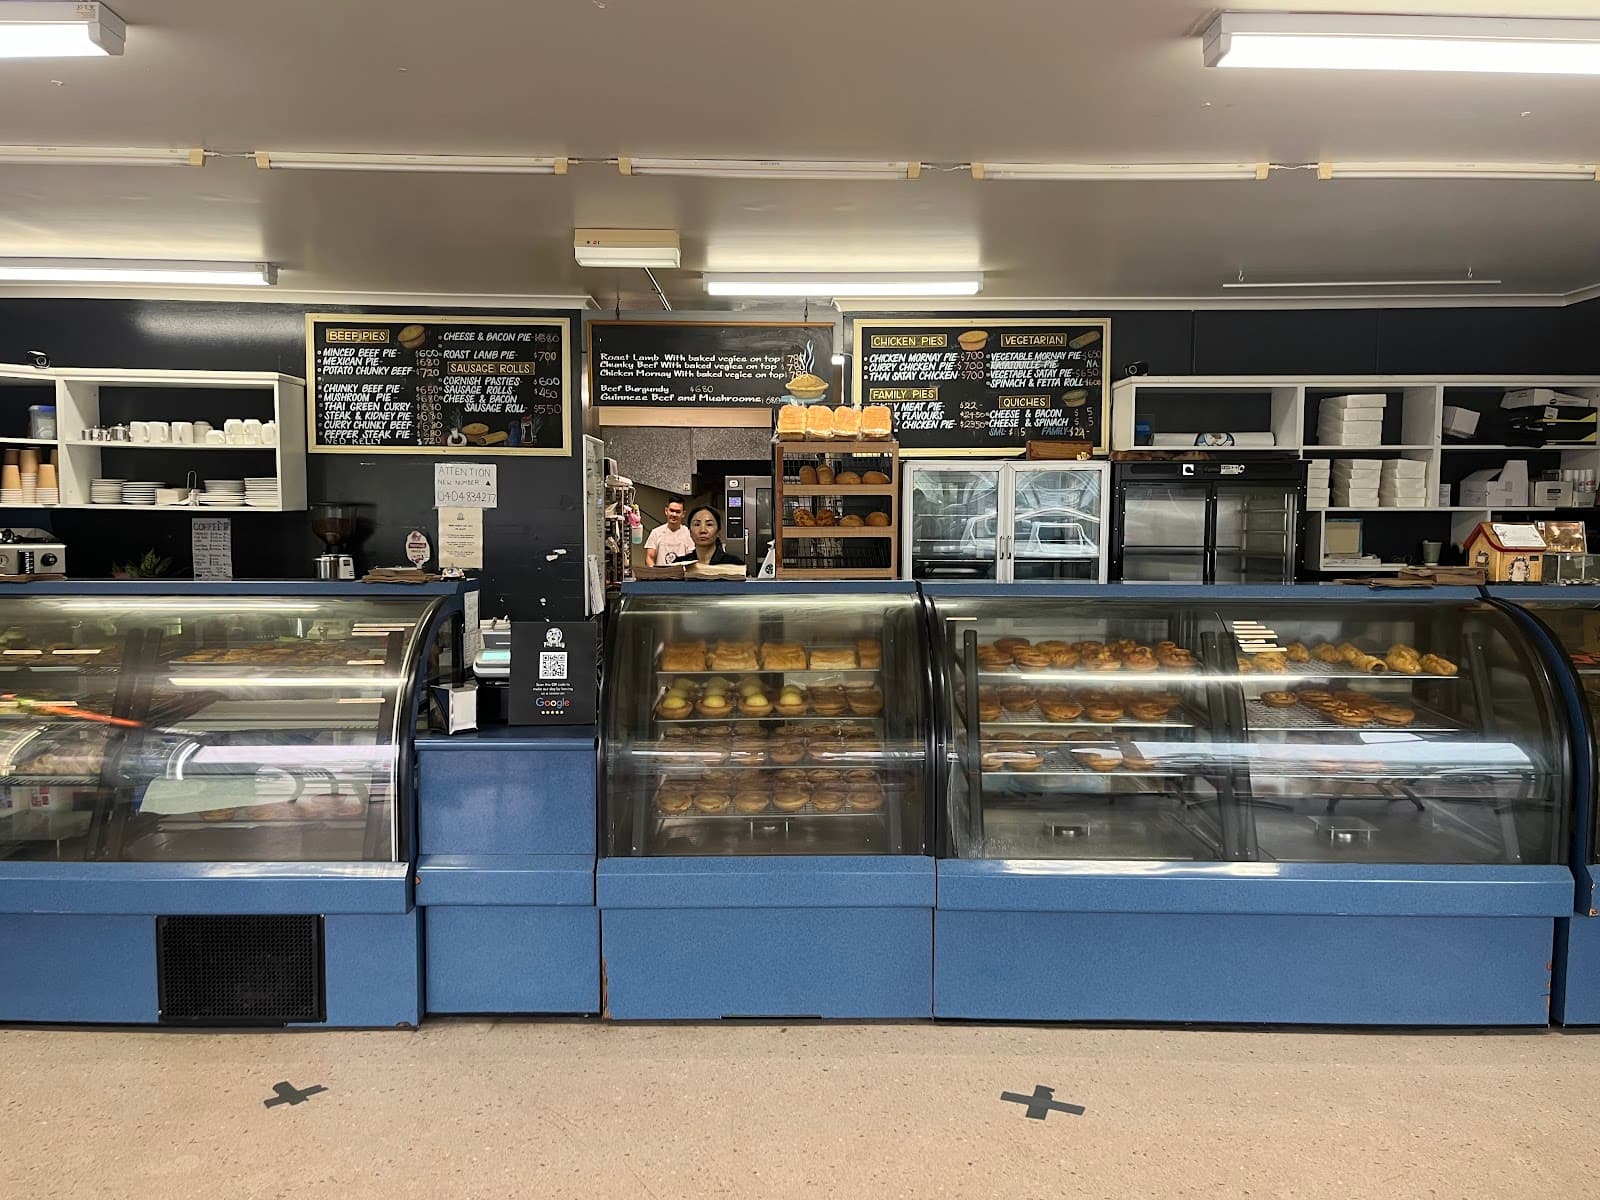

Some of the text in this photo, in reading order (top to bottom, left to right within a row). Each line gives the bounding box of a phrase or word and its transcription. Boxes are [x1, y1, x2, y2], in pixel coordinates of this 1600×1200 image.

[330, 331, 386, 340] BEEF PIES
[444, 332, 475, 340] CHEESE
[477, 333, 484, 341] &
[486, 333, 515, 341] BACON
[873, 337, 944, 346] CHICKEN PIES
[1005, 336, 1063, 345] VEGETARIAN
[323, 348, 355, 357] MINCED
[358, 349, 380, 357] BEEF
[443, 350, 471, 359] ROAST
[474, 350, 498, 359] LAMB
[991, 352, 1033, 361] VEGETABLE
[1034, 352, 1066, 360] MORNAY
[323, 357, 362, 366] MEXICAN
[688, 354, 715, 362] baked
[765, 355, 781, 363] top
[869, 353, 906, 363] CHICKEN
[909, 353, 943, 362] MORNAY
[323, 366, 354, 375] POTATO
[355, 367, 390, 375] CHUNKY
[451, 364, 530, 373] SAUSAGE ROLLS
[600, 361, 634, 369] Chunky
[760, 363, 777, 371] top
[869, 363, 897, 372] CURRY
[899, 362, 936, 371] CHICKEN
[636, 370, 671, 378] Mornay
[769, 371, 784, 379] top
[869, 372, 890, 381] THAI
[892, 371, 917, 380] SATAY
[990, 370, 1033, 379] VEGETABLE
[1034, 369, 1056, 378] SATAY
[443, 376, 481, 385] CORNISH
[990, 379, 1025, 388] SPINACH
[1028, 379, 1034, 387] &
[1037, 379, 1060, 387] FETTA
[323, 384, 358, 393] CHUNKY
[362, 384, 384, 392] BEEF
[443, 386, 482, 394] SAUSAGE
[625, 385, 670, 394] Burgundy
[324, 393, 370, 402] MUSHROOM
[443, 394, 517, 404] CHEESE & BACON
[873, 390, 934, 399] FAMILY PIES
[324, 402, 345, 410] THAI
[350, 402, 380, 410] GREEN
[902, 402, 926, 411] MEAT
[1003, 398, 1046, 407] QUICHES
[464, 404, 502, 412] SAUSAGE
[324, 411, 352, 420] STEAK
[355, 412, 362, 420] &
[365, 412, 395, 420] KIDNEY
[902, 411, 944, 420] FLAVOURS
[990, 409, 1020, 418] CHEESE
[1025, 409, 1031, 418] &
[1035, 409, 1062, 418] BACON
[324, 421, 352, 429] CURRY
[354, 421, 387, 429] CHUNKY
[902, 420, 938, 429] CHICKEN
[989, 419, 1019, 428] CHEESE
[1025, 419, 1032, 427] &
[1034, 418, 1069, 427] SPINACH
[324, 430, 358, 439] PEPPER
[362, 430, 391, 439] STEAK
[439, 466, 490, 477] ATTENTION
[535, 697, 570, 709] Google
